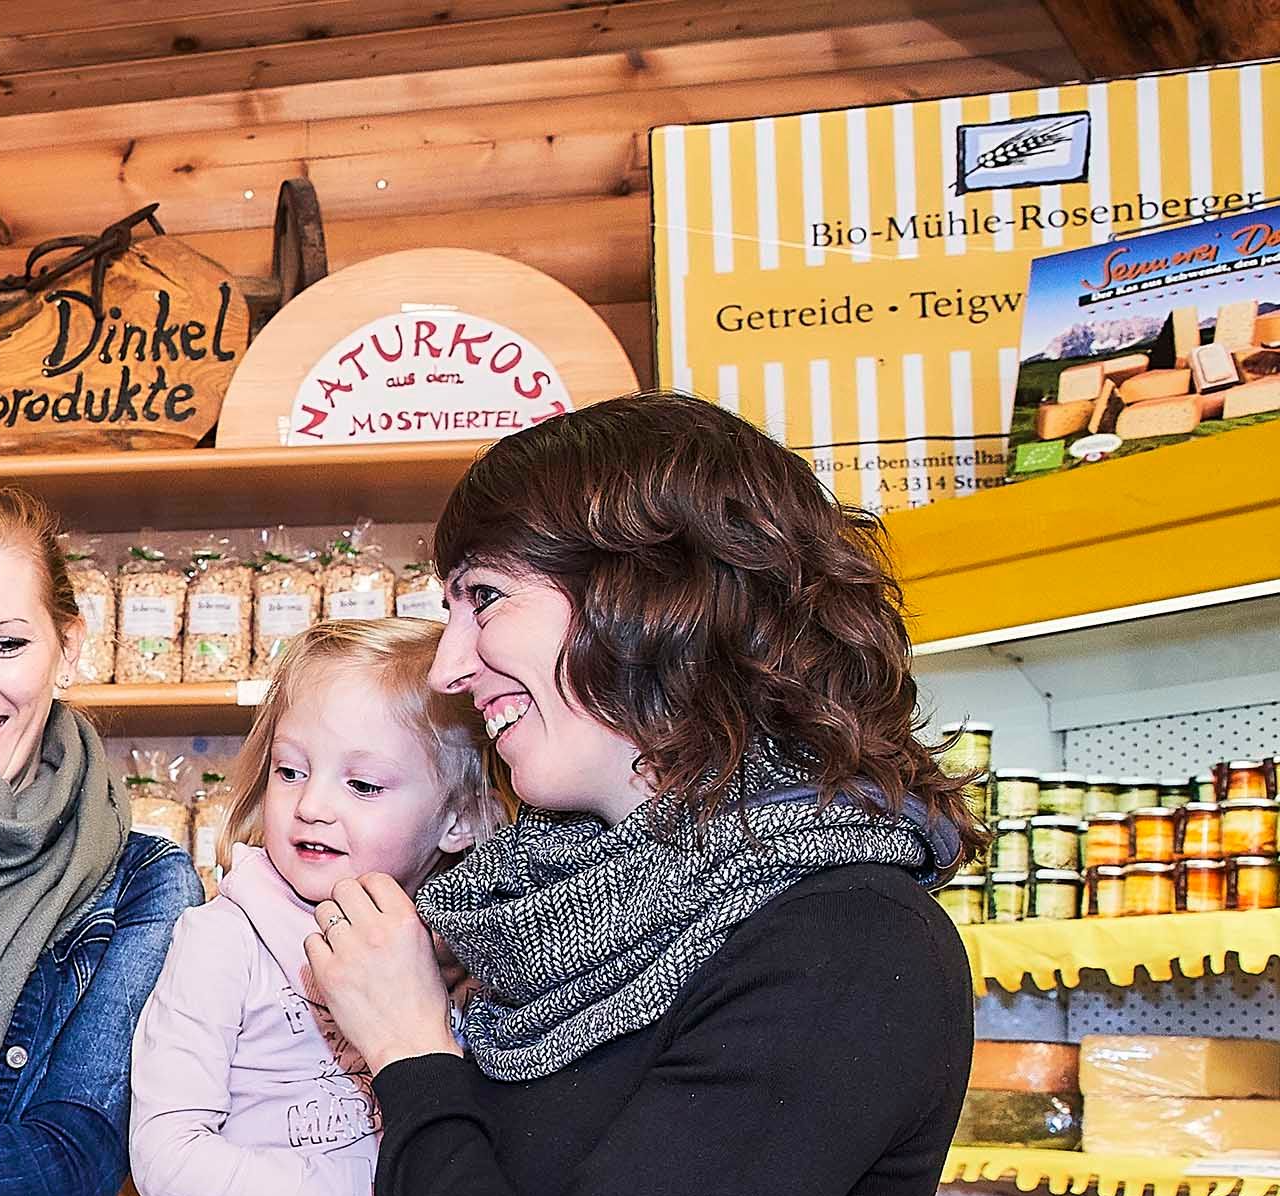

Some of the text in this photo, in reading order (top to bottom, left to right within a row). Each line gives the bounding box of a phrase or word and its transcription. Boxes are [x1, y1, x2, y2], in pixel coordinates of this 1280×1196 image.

[810, 189, 1262, 248] Bio-Mühle-Rosenberger
[41, 280, 237, 378] Dinkel
[715, 295, 874, 332] Getreide
[385, 365, 465, 388] aus dem
[348, 409, 523, 437] MOSTVIERTEL
[878, 474, 946, 493] A-3314
